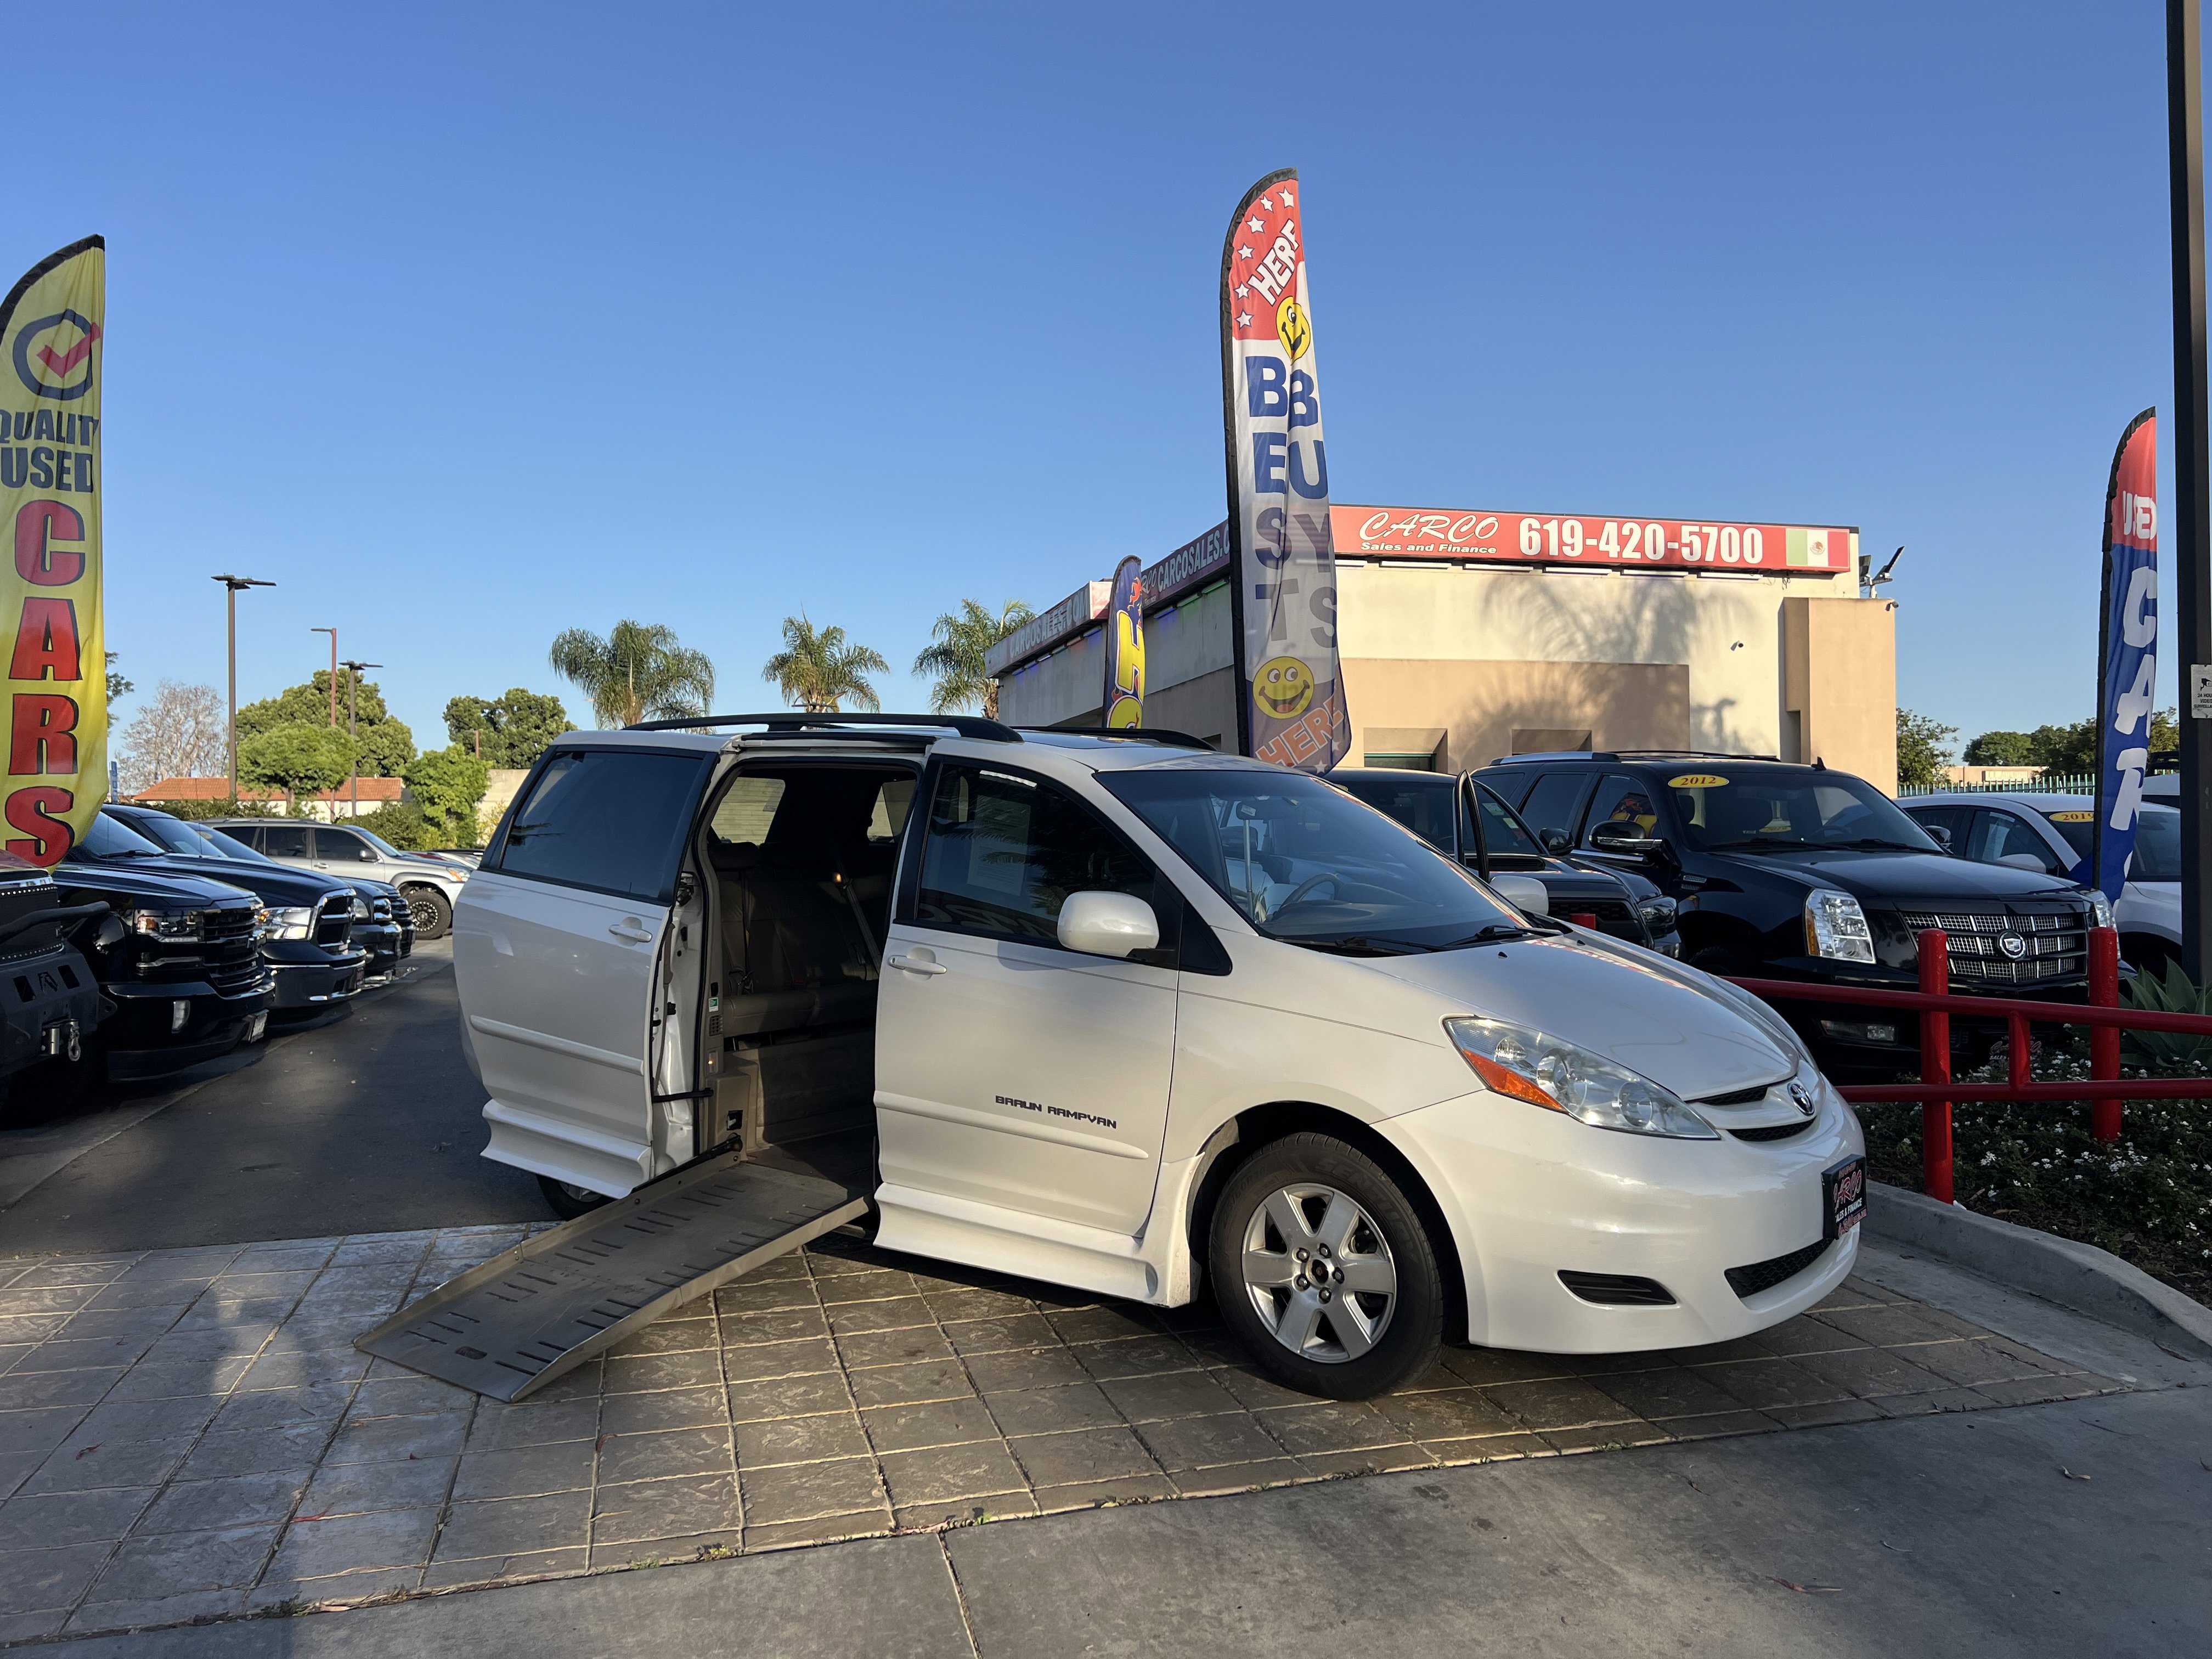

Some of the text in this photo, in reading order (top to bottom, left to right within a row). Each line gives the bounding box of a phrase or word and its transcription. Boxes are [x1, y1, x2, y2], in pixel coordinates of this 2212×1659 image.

[1, 446, 94, 493] USED
[1358, 511, 1499, 543] CARCO
[1519, 517, 1763, 564] 619-420-5700
[1361, 541, 1497, 554] Sales and Finance
[5, 499, 86, 867] CARS
[1680, 776, 1716, 786] 2012
[995, 1095, 1117, 1129] BRAUN RAMPVAN
